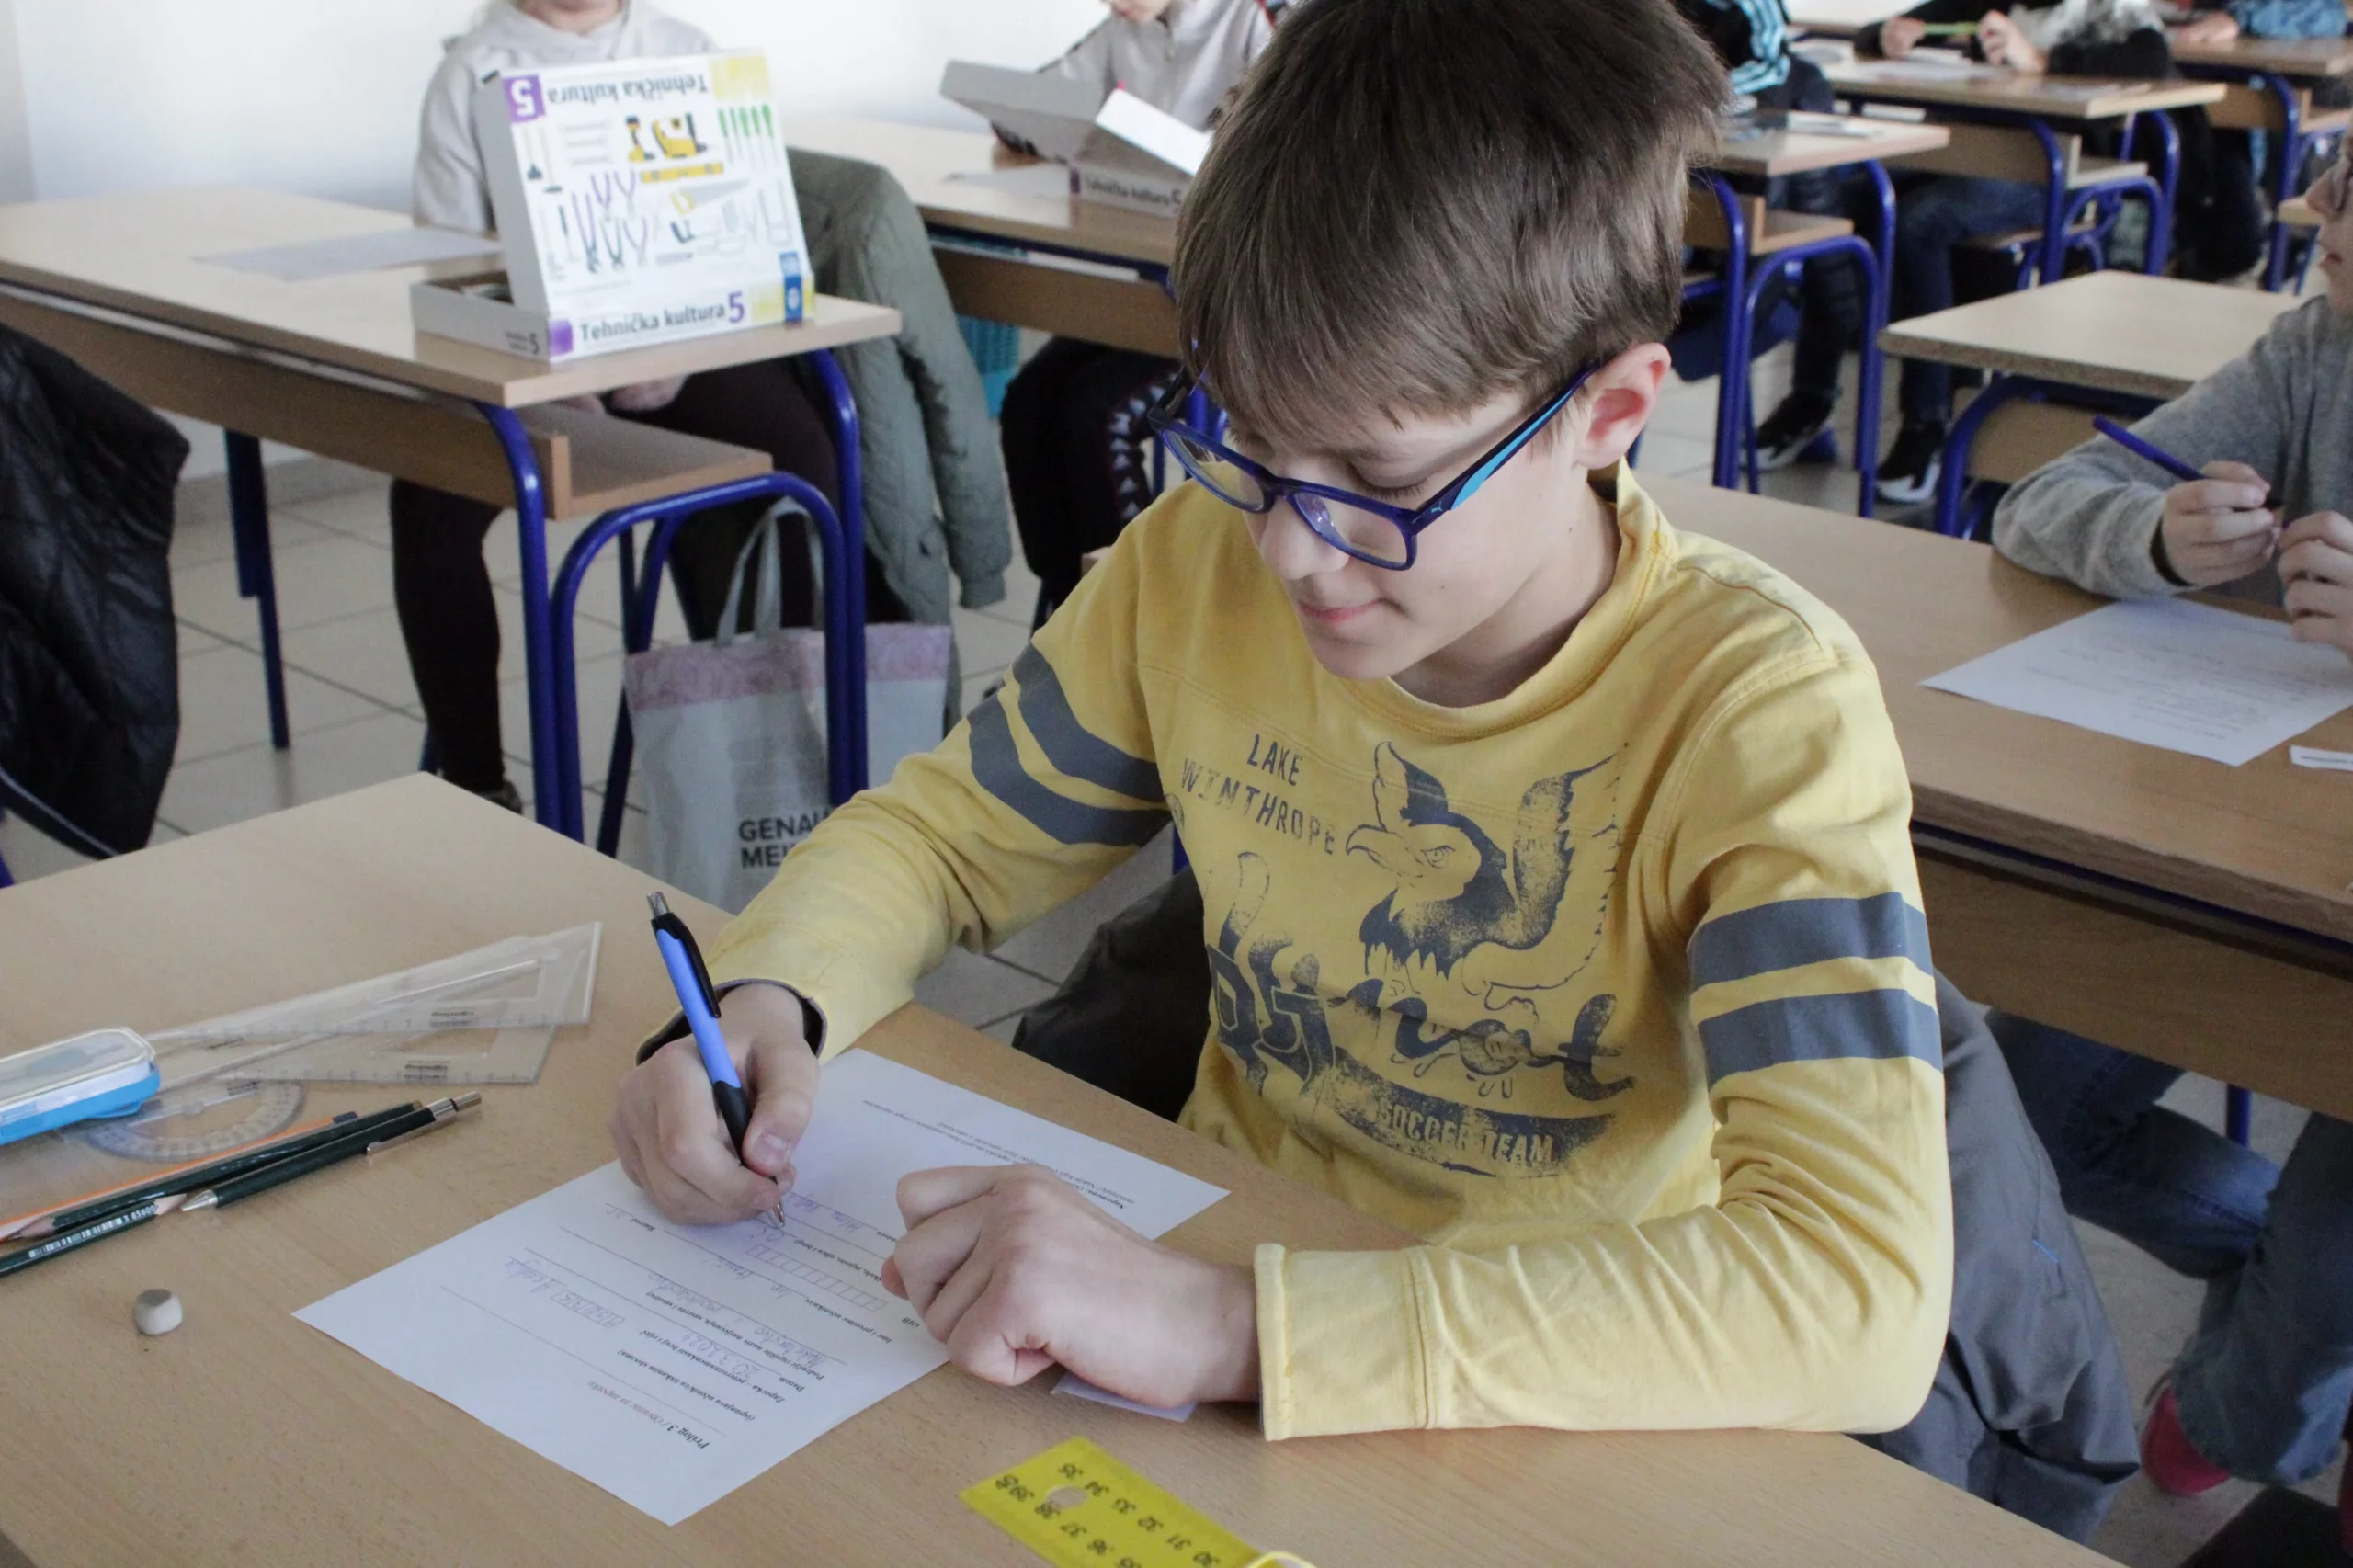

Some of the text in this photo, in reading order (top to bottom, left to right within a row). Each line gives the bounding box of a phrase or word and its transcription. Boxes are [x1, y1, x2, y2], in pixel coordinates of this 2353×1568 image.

[511, 74, 708, 117] Tehnička kultura 5
[580, 290, 745, 341] Tehnička kultura 5
[1246, 734, 1303, 786] LAKE
[1182, 757, 1335, 855] WINTHROPE
[1376, 1098, 1553, 1167] SOCCER TEAM
[677, 1427, 710, 1449] Prilog
